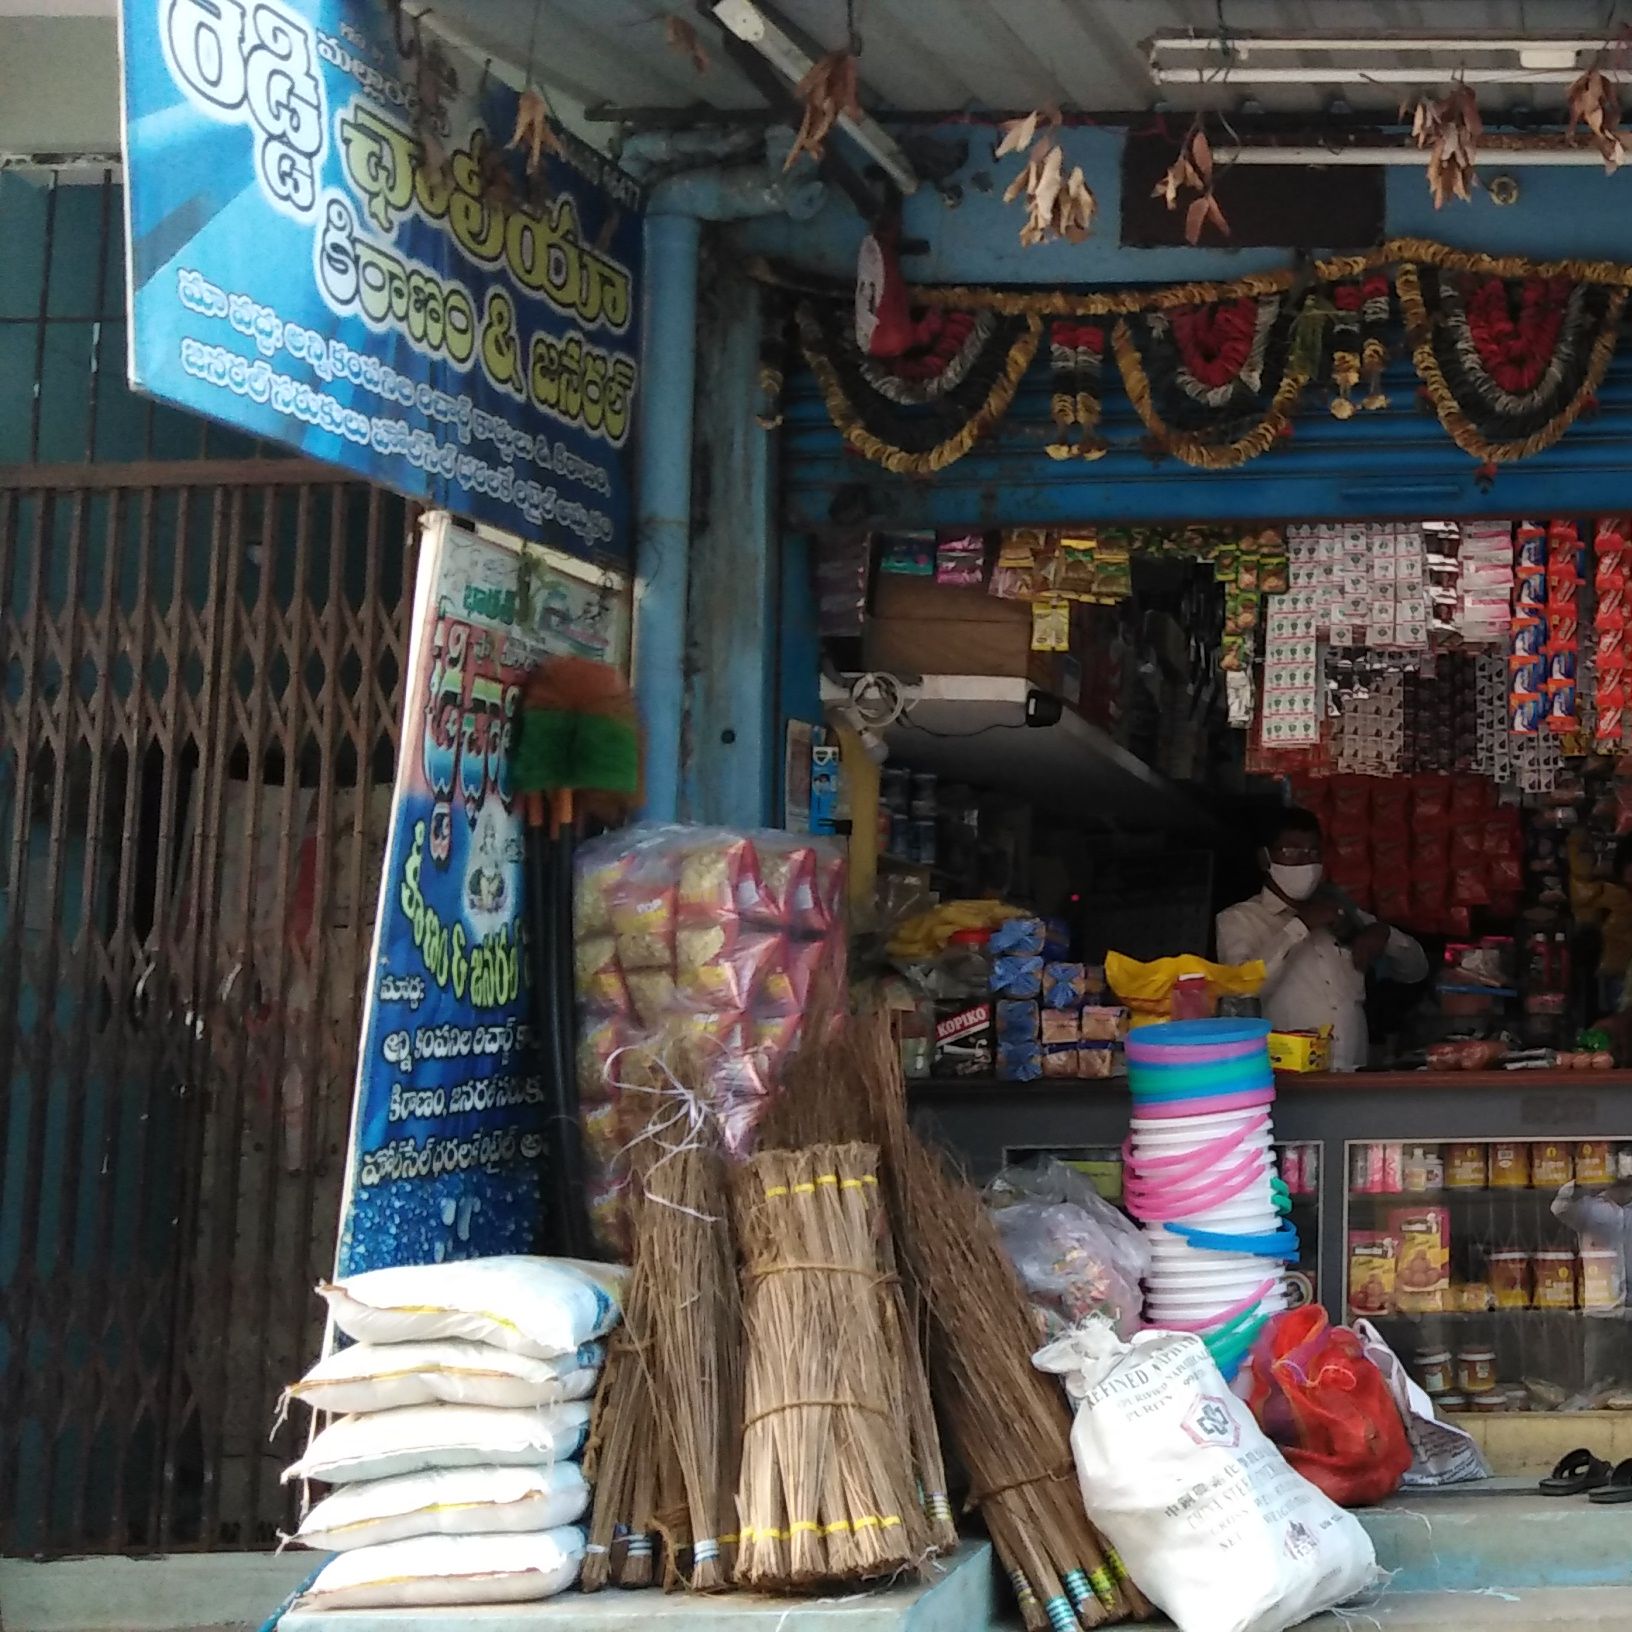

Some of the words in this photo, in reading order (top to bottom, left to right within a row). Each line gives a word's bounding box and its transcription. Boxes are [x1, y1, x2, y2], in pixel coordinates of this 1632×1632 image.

[320, 198, 474, 364] కిరాణం
[482, 291, 523, 395] &
[936, 1005, 987, 1038] KOPIKO
